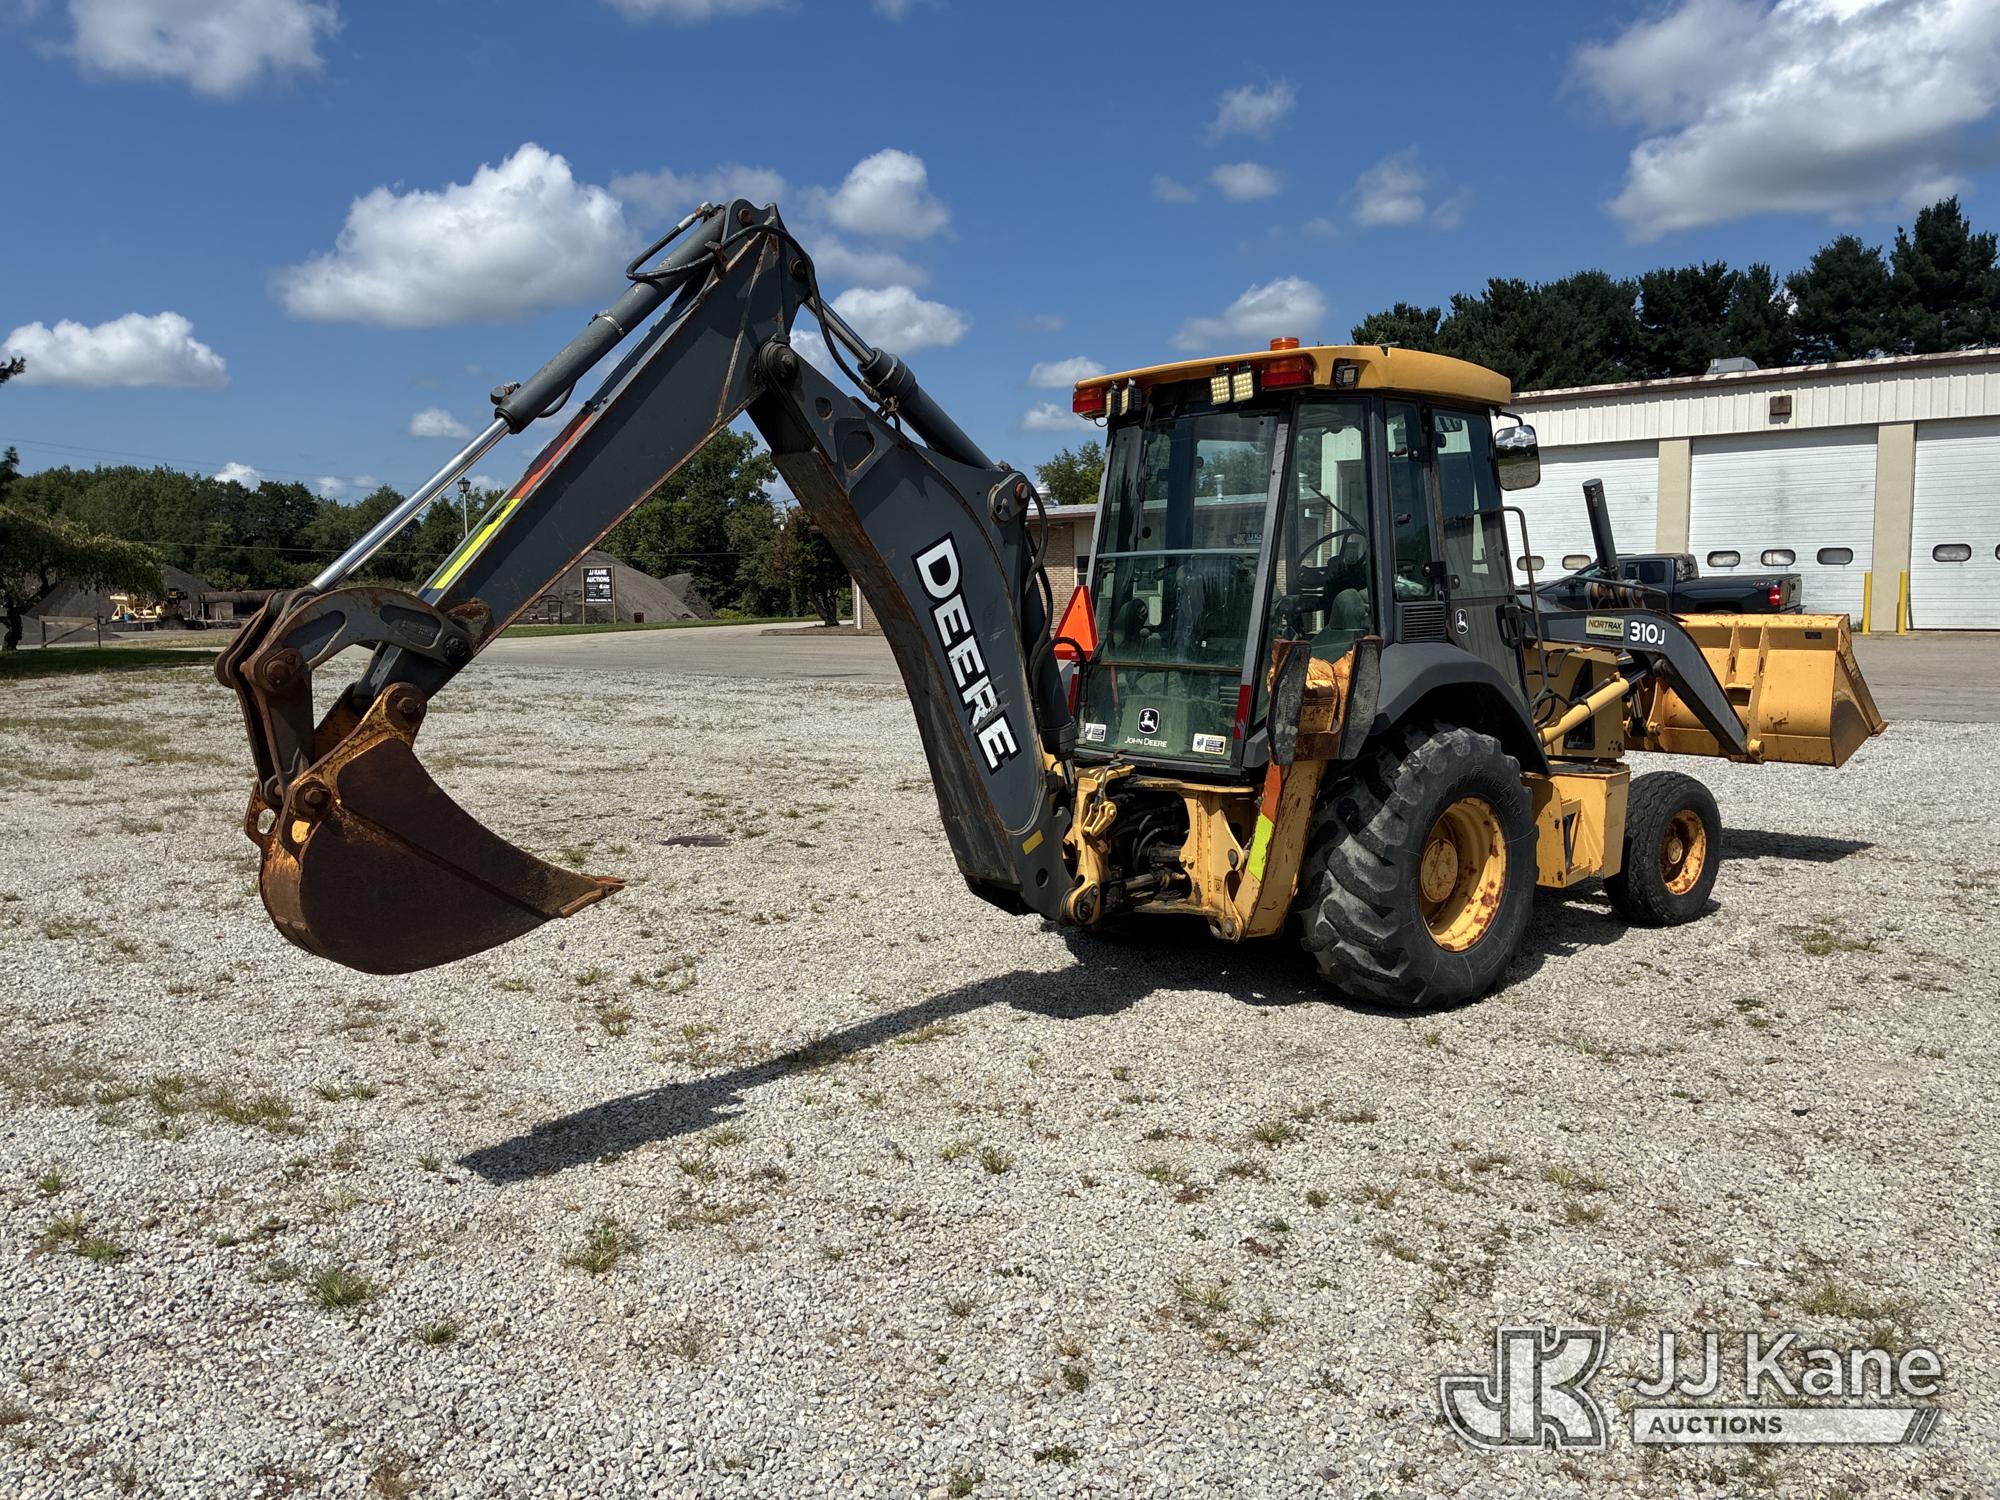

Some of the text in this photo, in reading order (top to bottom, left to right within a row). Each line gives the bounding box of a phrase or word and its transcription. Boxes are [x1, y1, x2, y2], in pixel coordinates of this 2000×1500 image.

[1588, 619, 1622, 630] NORTRAX
[1629, 621, 1665, 645] 310J
[915, 537, 1018, 770] DEERE
[1124, 735, 1168, 748] JOHN DEERE
